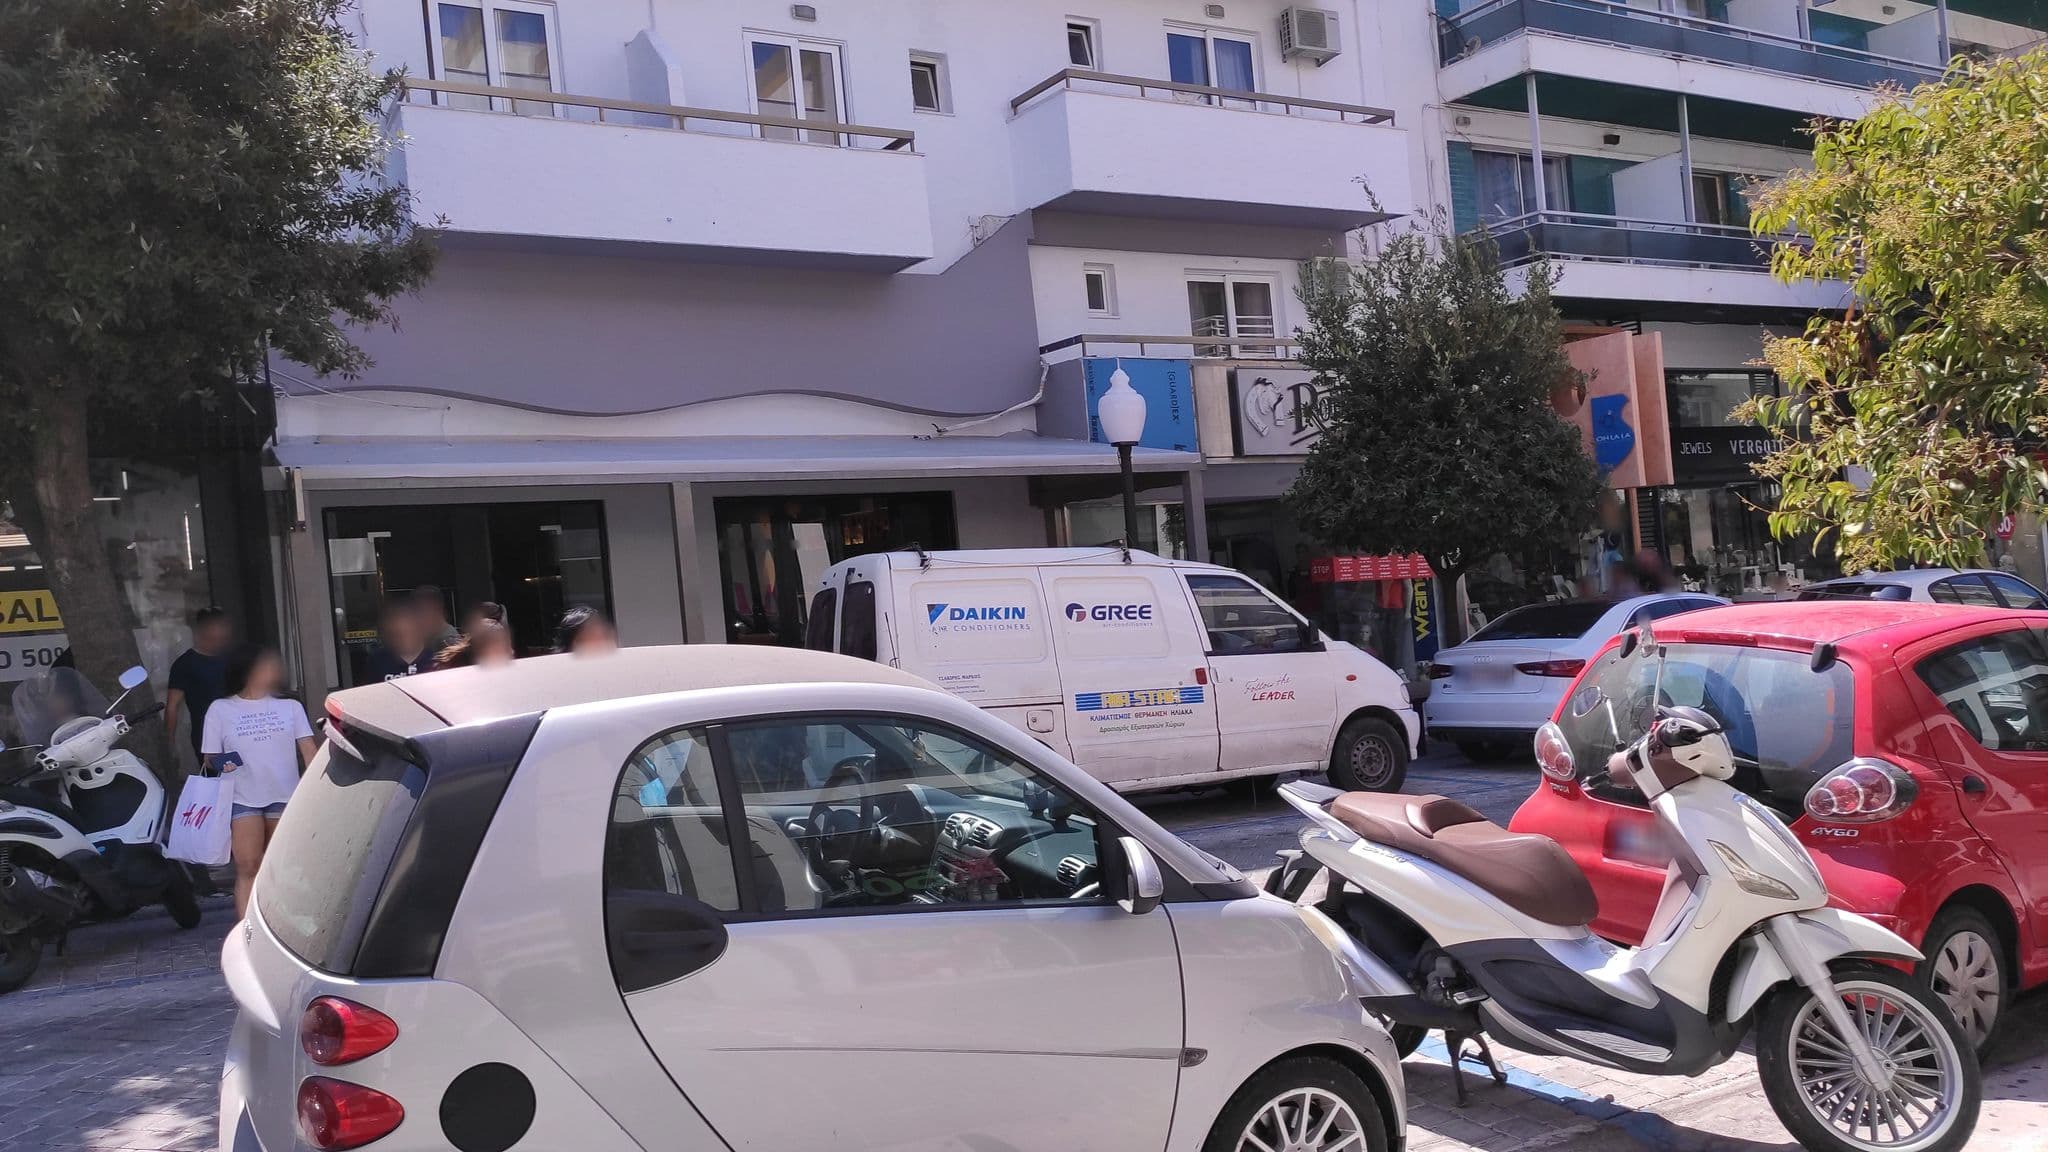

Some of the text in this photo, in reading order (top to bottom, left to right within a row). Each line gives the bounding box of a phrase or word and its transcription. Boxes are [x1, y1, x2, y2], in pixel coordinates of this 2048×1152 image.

[1680, 442, 1712, 455] JEWELS
[0, 597, 59, 624] AL
[949, 607, 1025, 621] DAIKIN
[1091, 604, 1152, 620] GREE
[1414, 578, 1431, 642] Wran
[953, 623, 1031, 632] CONDITIONERS
[1134, 689, 1180, 706] STAR
[1251, 690, 1296, 701] LEADER
[1170, 708, 1193, 716] ΗΛΙΑΚΑ
[1811, 827, 1859, 837] AYGO
